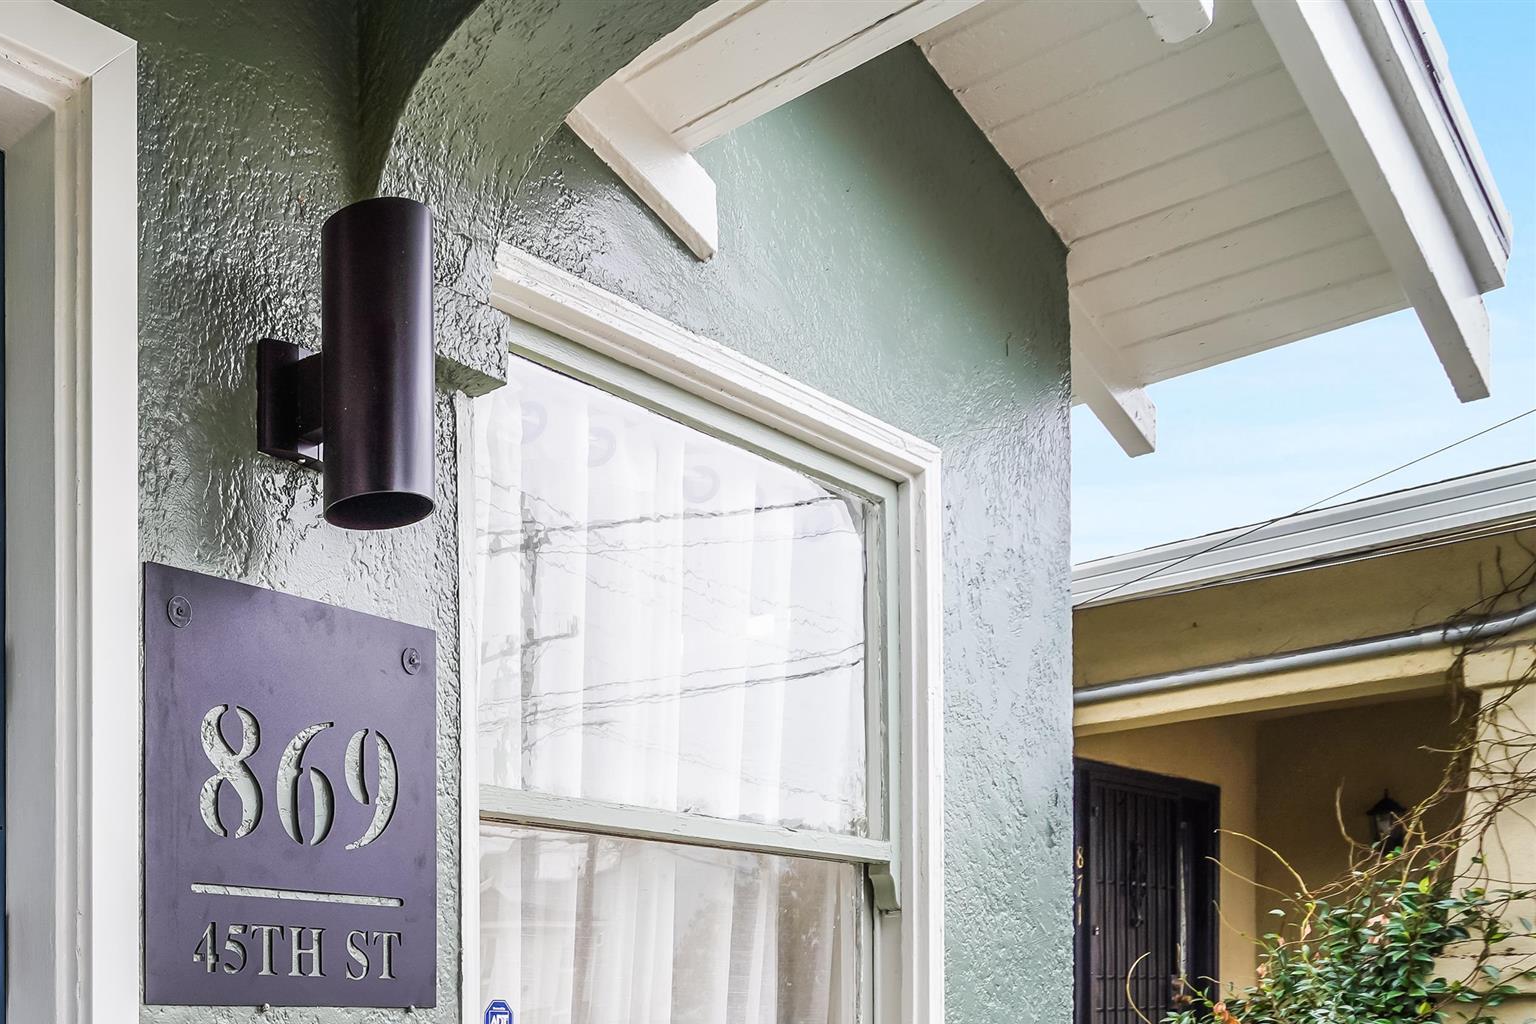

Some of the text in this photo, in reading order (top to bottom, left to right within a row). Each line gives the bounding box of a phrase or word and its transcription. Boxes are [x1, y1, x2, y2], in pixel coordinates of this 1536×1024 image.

[199, 703, 399, 851] 869
[192, 921, 403, 981] 45TH ST
